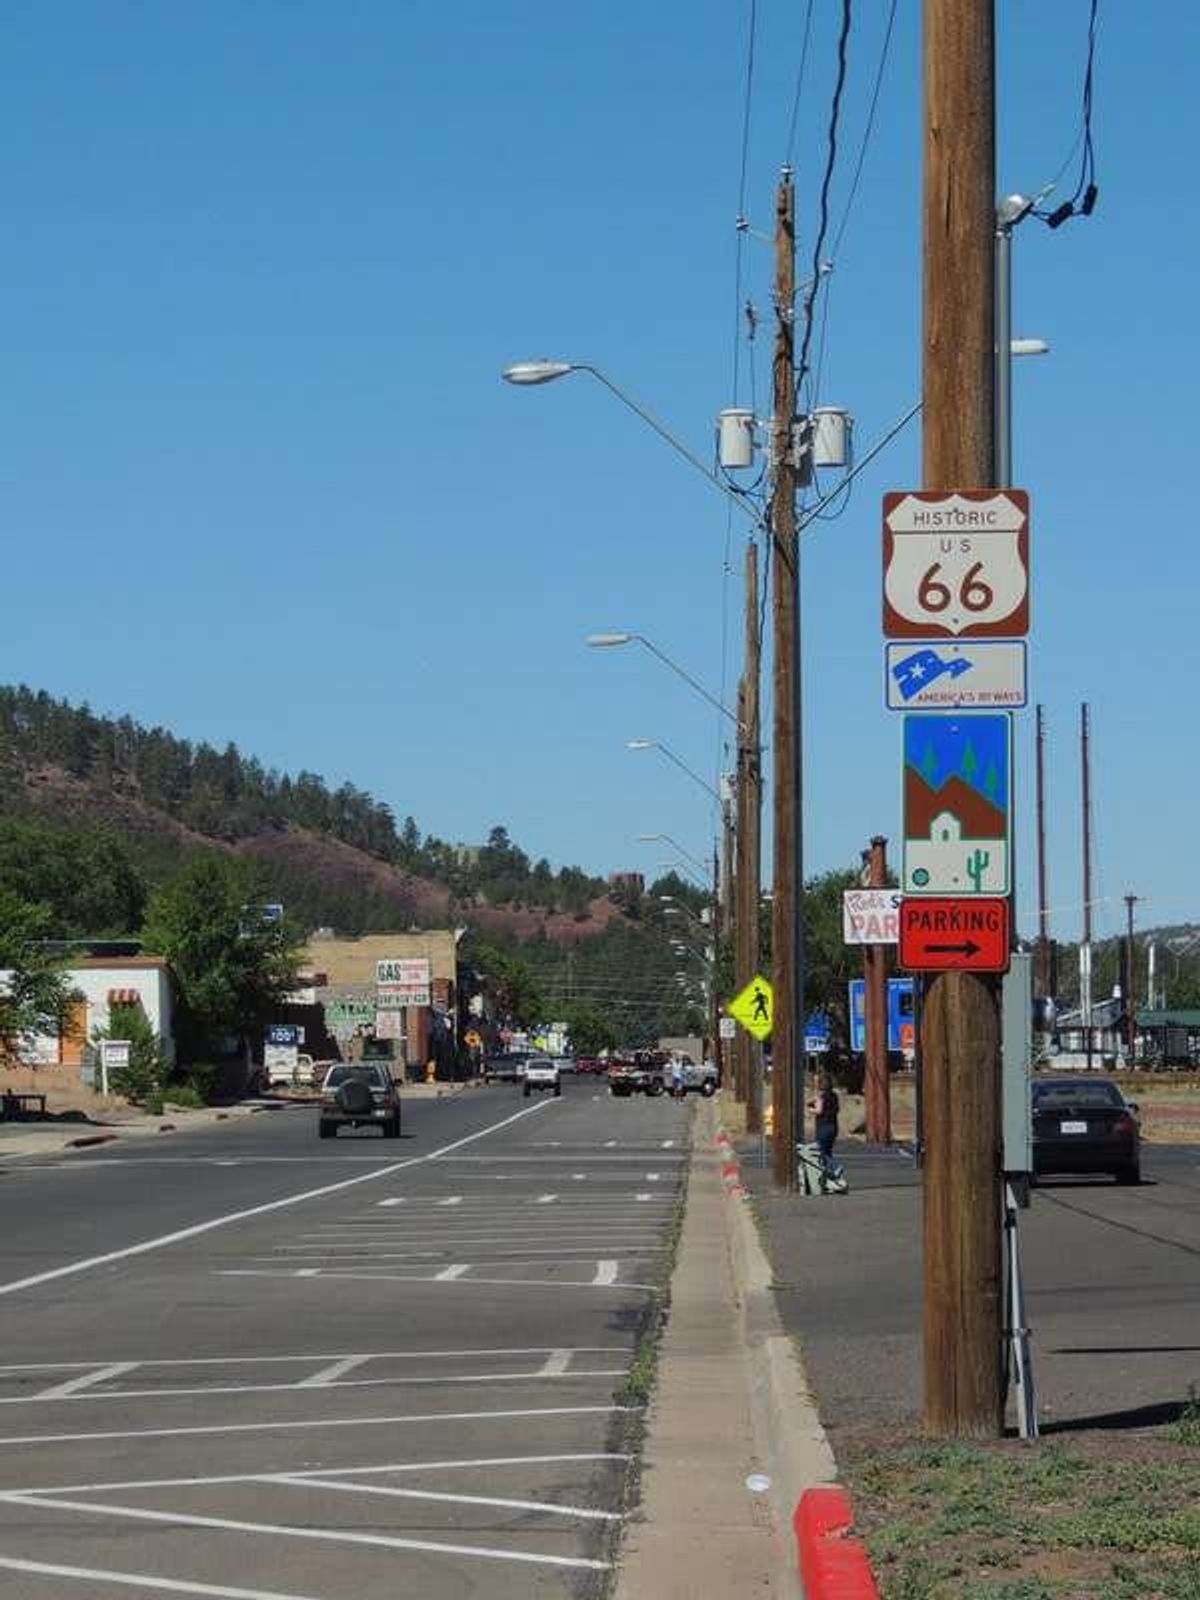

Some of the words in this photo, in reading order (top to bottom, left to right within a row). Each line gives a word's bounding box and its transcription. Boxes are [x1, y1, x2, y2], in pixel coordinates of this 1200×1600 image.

[913, 510, 998, 526] HISTORIC
[918, 561, 994, 613] 66
[916, 690, 976, 704] AMERICA'S
[849, 913, 898, 940] PAR
[907, 909, 999, 932] PARKING
[377, 963, 401, 981] GAS
